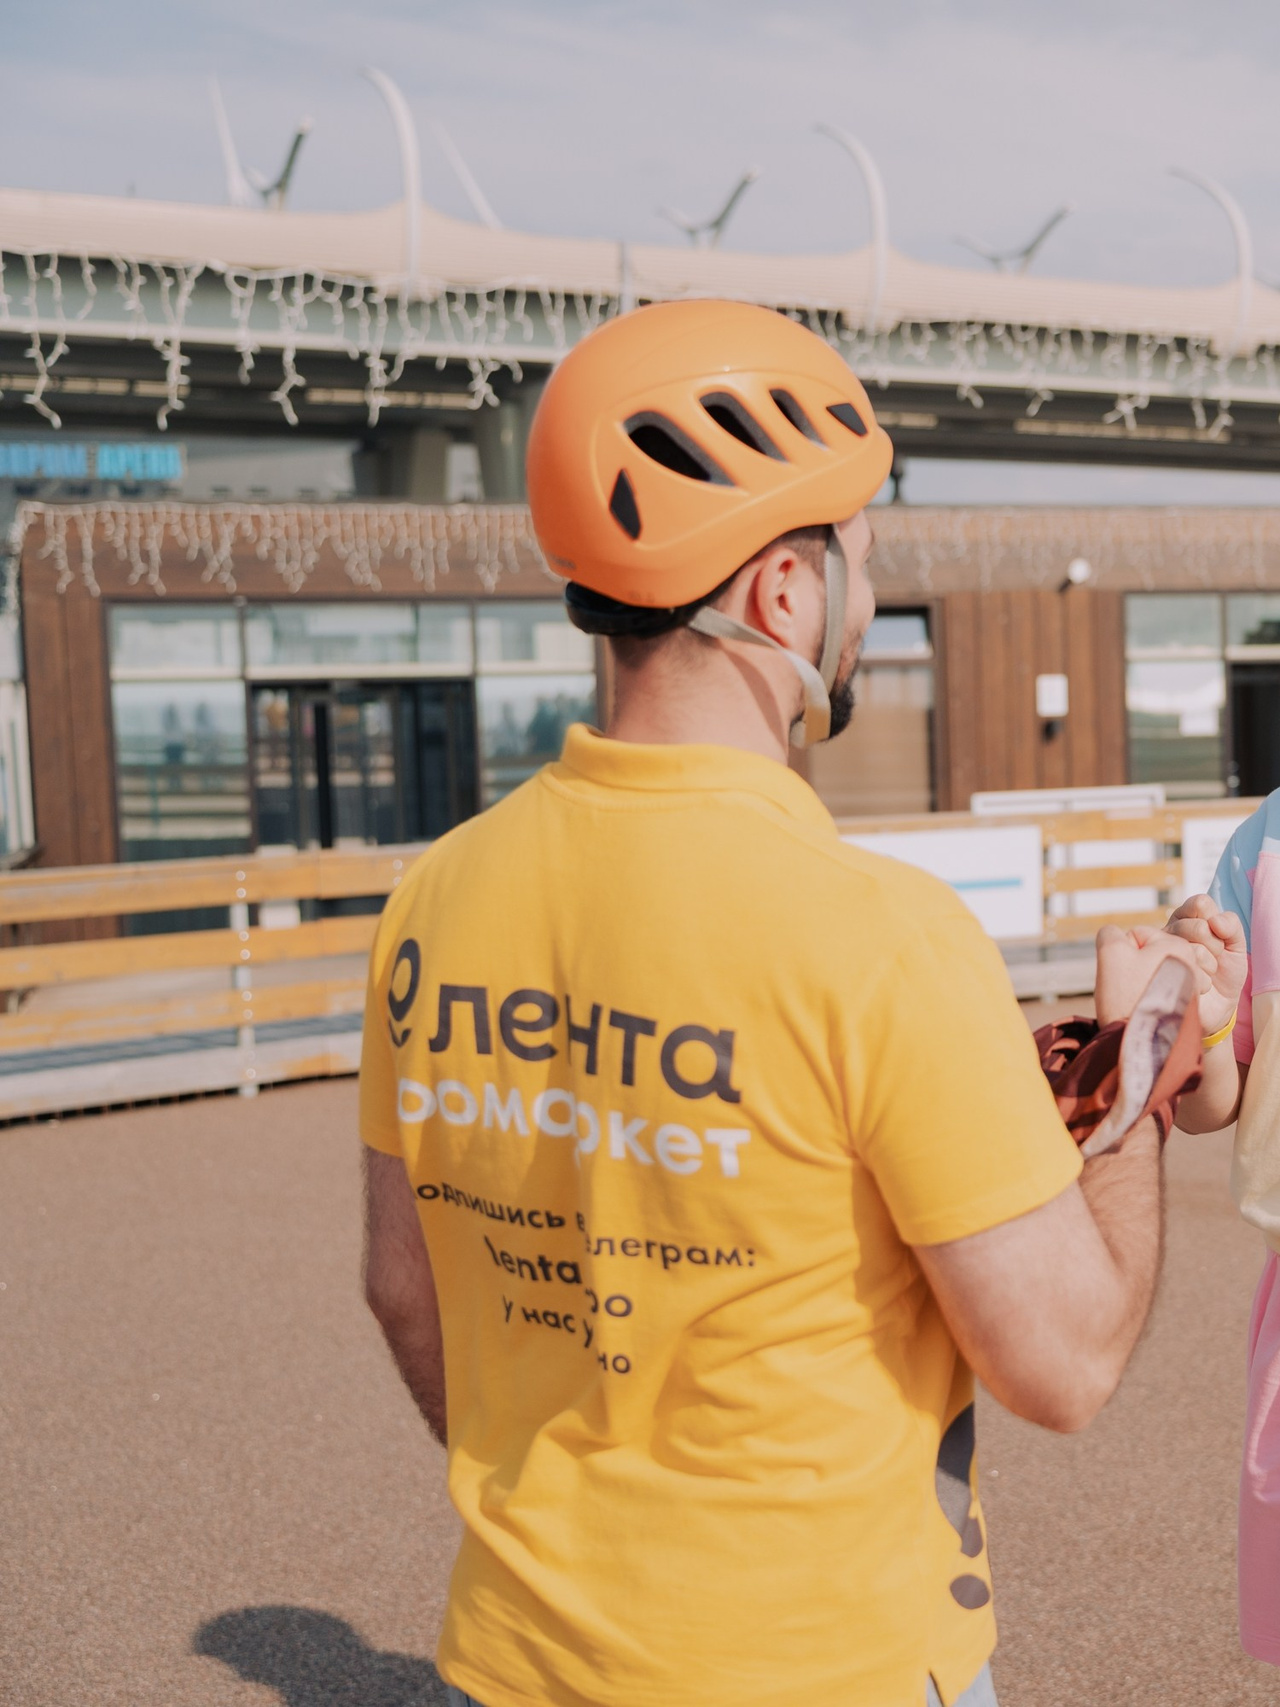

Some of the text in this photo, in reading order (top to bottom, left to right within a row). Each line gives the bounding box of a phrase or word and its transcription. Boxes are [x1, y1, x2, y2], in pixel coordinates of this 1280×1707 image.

[428, 982, 742, 1104] лента
[416, 1181, 566, 1229] одпишись
[584, 1231, 756, 1271] леграм:
[521, 1305, 577, 1334] нас
